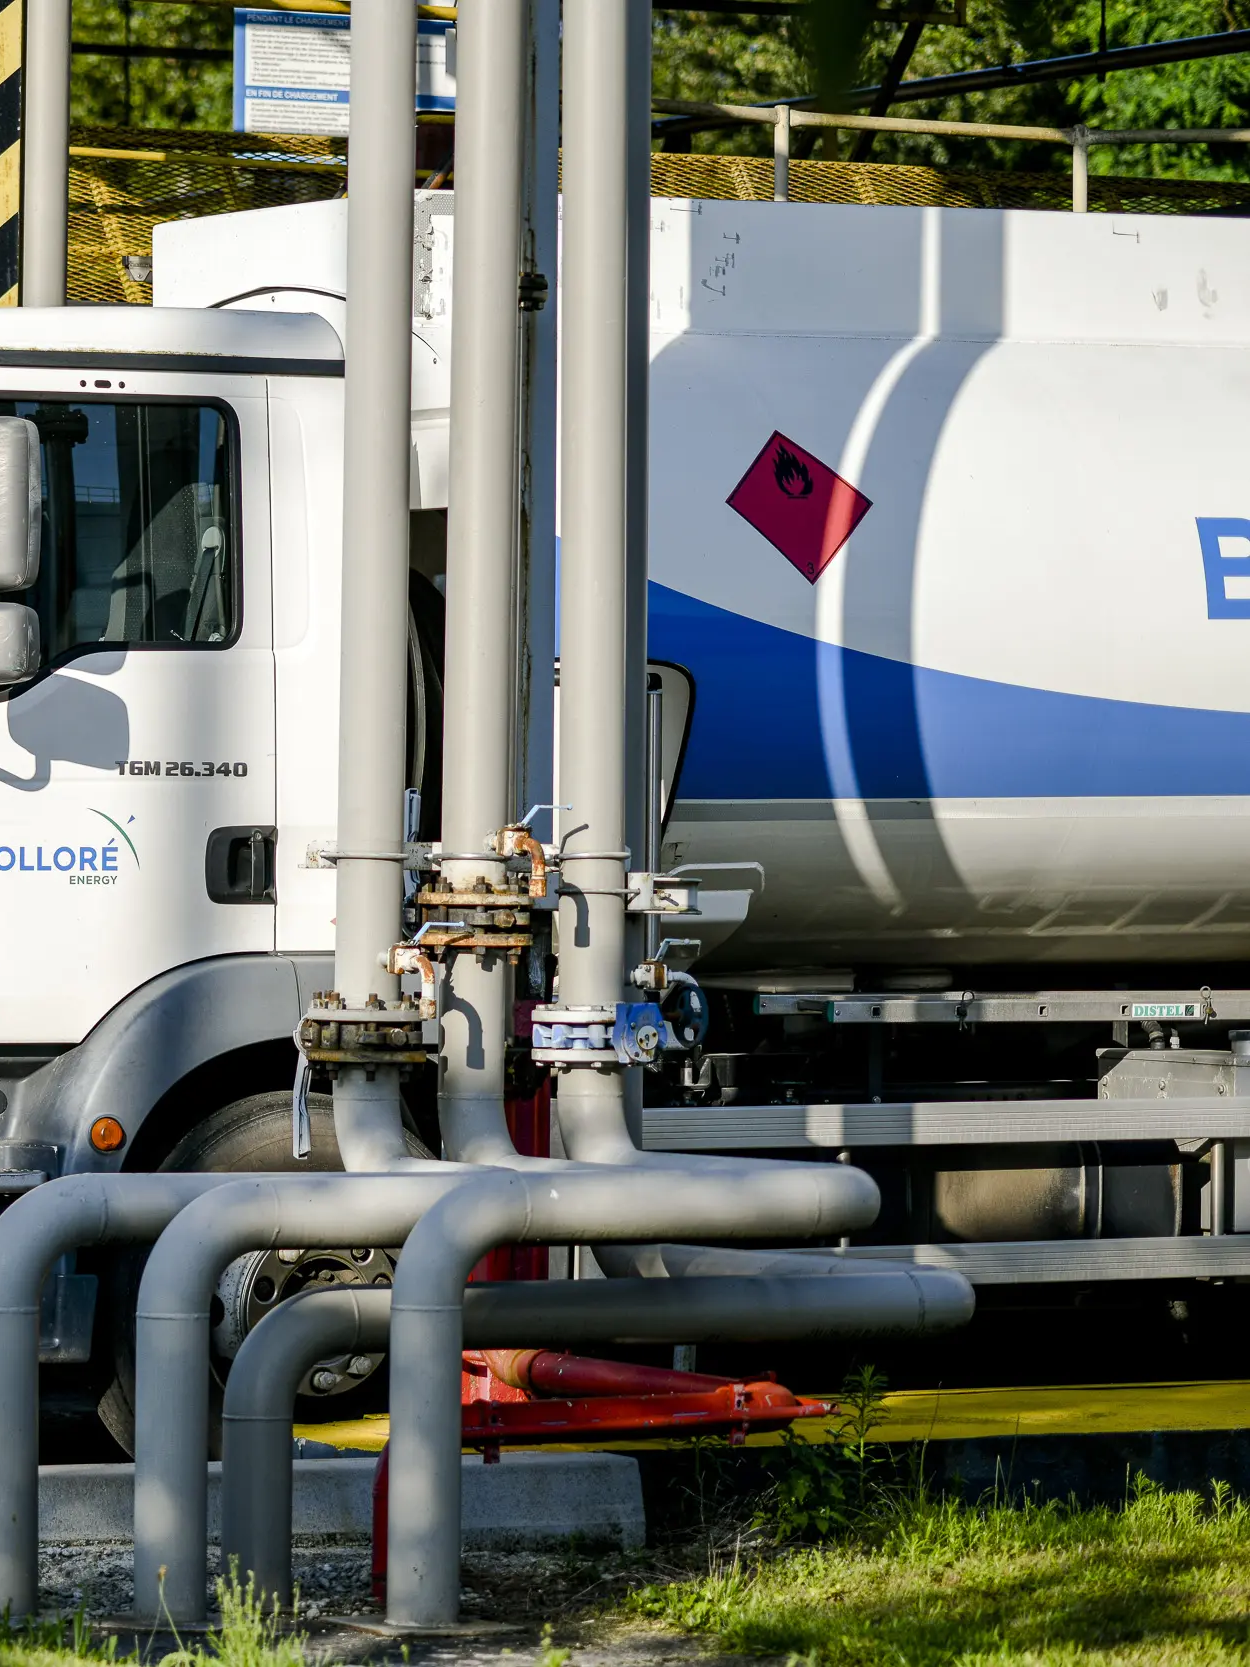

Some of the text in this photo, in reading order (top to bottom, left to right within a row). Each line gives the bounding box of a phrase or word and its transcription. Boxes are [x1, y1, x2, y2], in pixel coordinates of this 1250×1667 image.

[246, 13, 349, 27] PENDANT LE CHARGEMENT
[245, 88, 339, 102] EN FIN DE CHARGEMENT
[807, 561, 815, 575] 3
[115, 760, 248, 778] TGM 26.340
[69, 875, 118, 885] ENERGY
[1134, 1005, 1184, 1016] DISTEL
